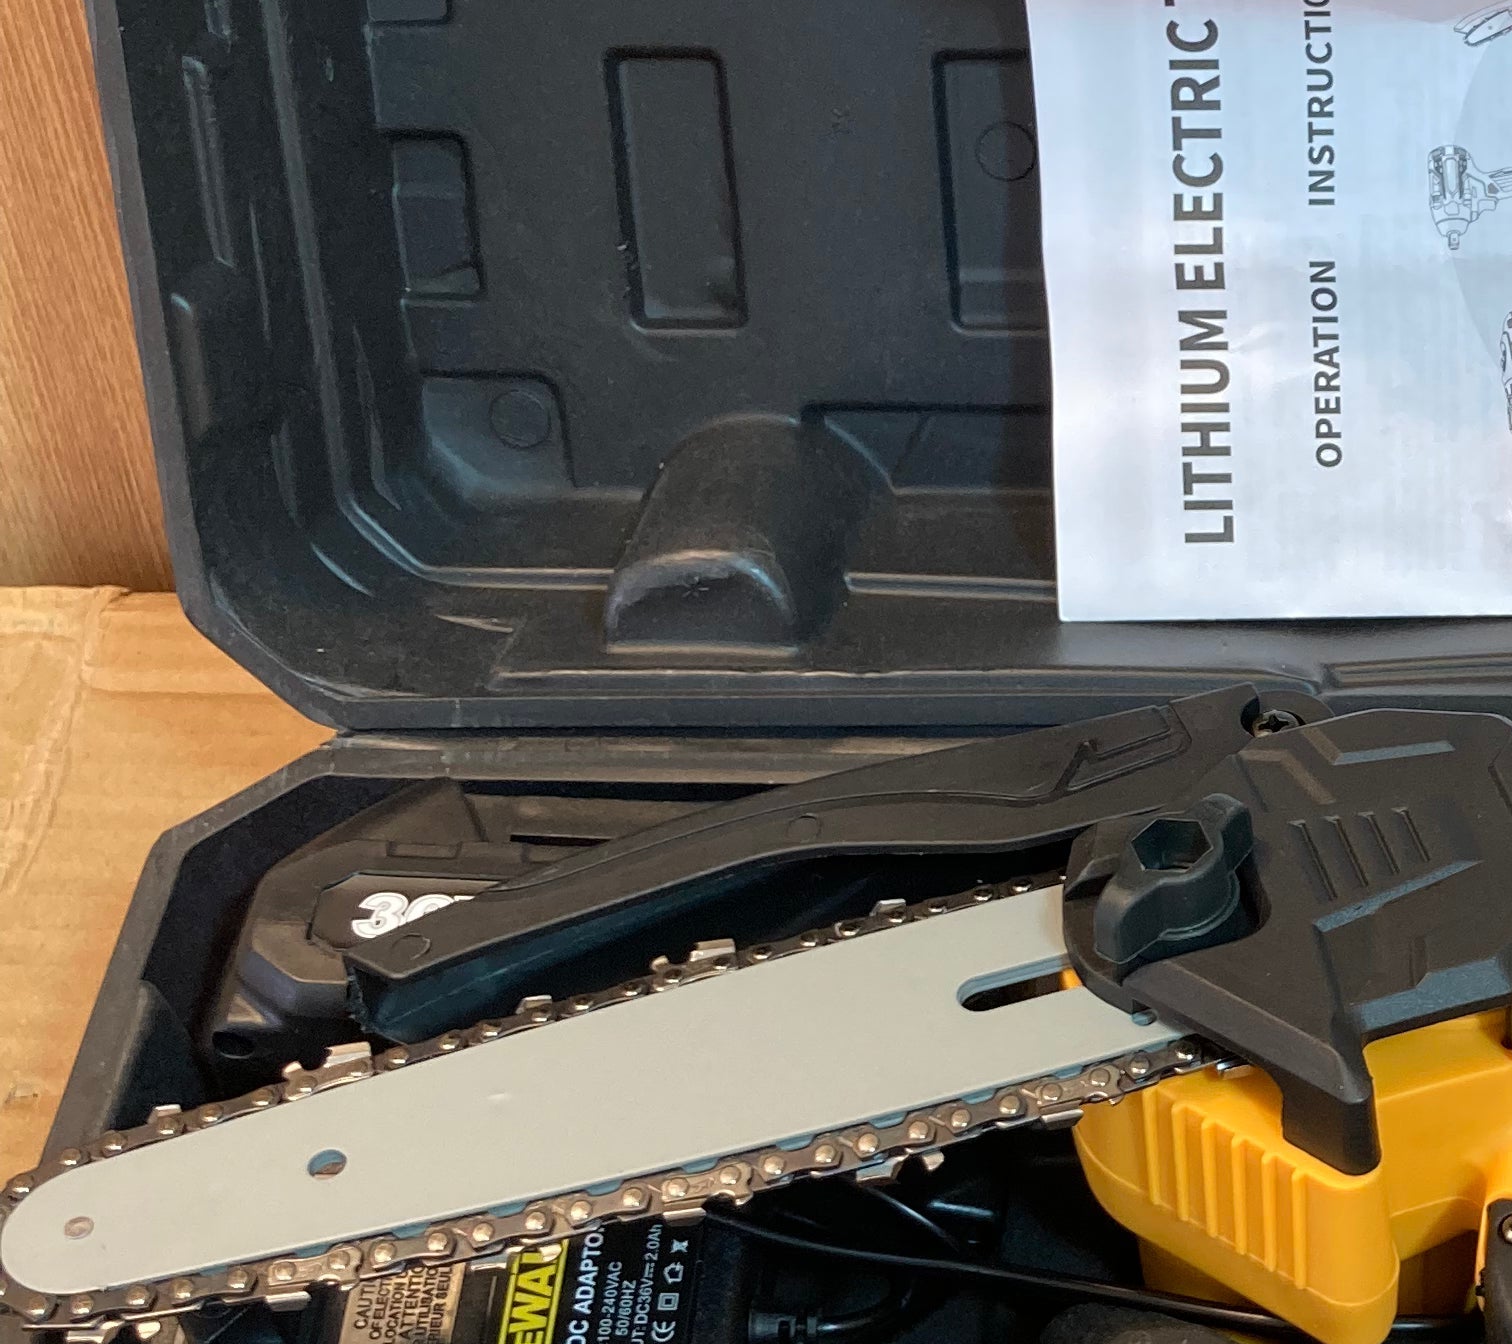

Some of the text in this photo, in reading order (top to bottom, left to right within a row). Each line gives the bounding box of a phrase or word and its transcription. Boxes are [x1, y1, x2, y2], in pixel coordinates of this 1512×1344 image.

[1166, 18, 1226, 290] ELECTRIC
[1309, 260, 1343, 468] OPERATION
[1178, 309, 1234, 544] LITHIUM
[354, 1283, 376, 1329] CAUTI
[398, 1266, 425, 1340] ATTENTIO
[415, 1266, 438, 1336] UTILISATIO
[573, 1228, 605, 1315] ADAPTO
[615, 1280, 637, 1337] 50/60HZ
[369, 1319, 382, 1340] OF
